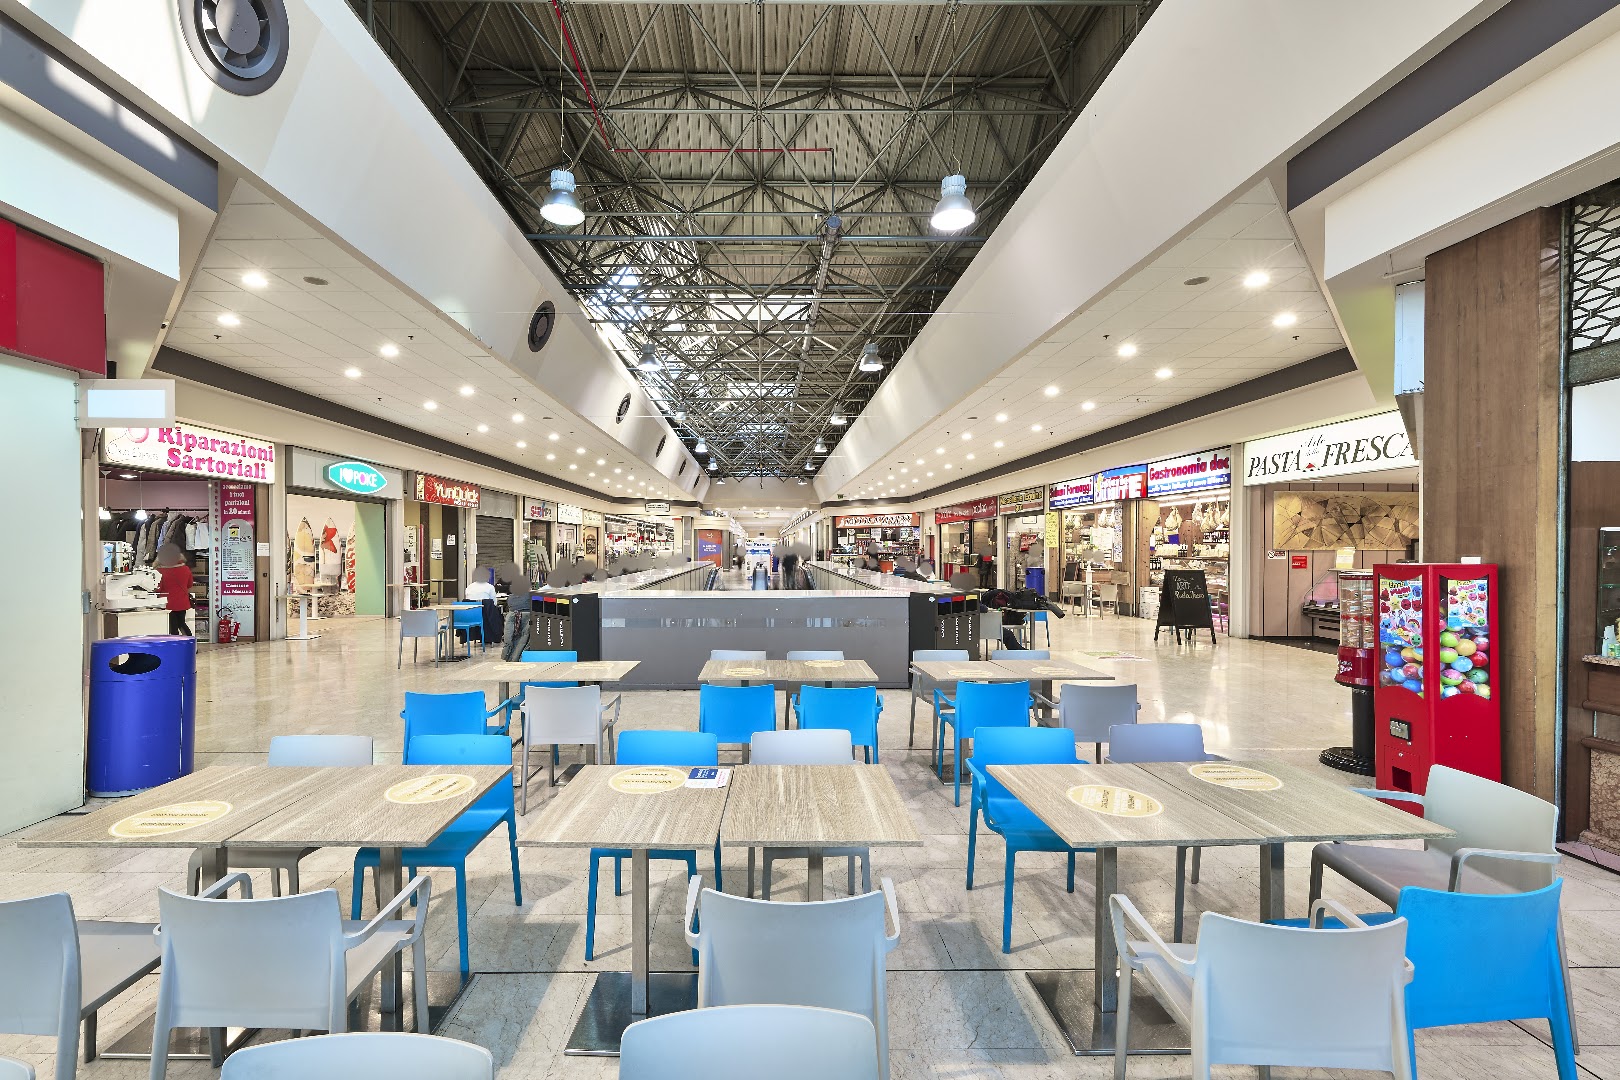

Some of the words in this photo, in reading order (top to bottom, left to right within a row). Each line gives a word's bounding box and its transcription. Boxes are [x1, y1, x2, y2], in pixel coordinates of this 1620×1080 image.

[158, 426, 274, 463] Riparazioni
[167, 447, 267, 480] Sartoriali
[1149, 457, 1207, 481] Gastronomia
[1247, 450, 1301, 477] PASTA
[353, 470, 378, 487] POKE
[1066, 479, 1092, 496] Formaggi
